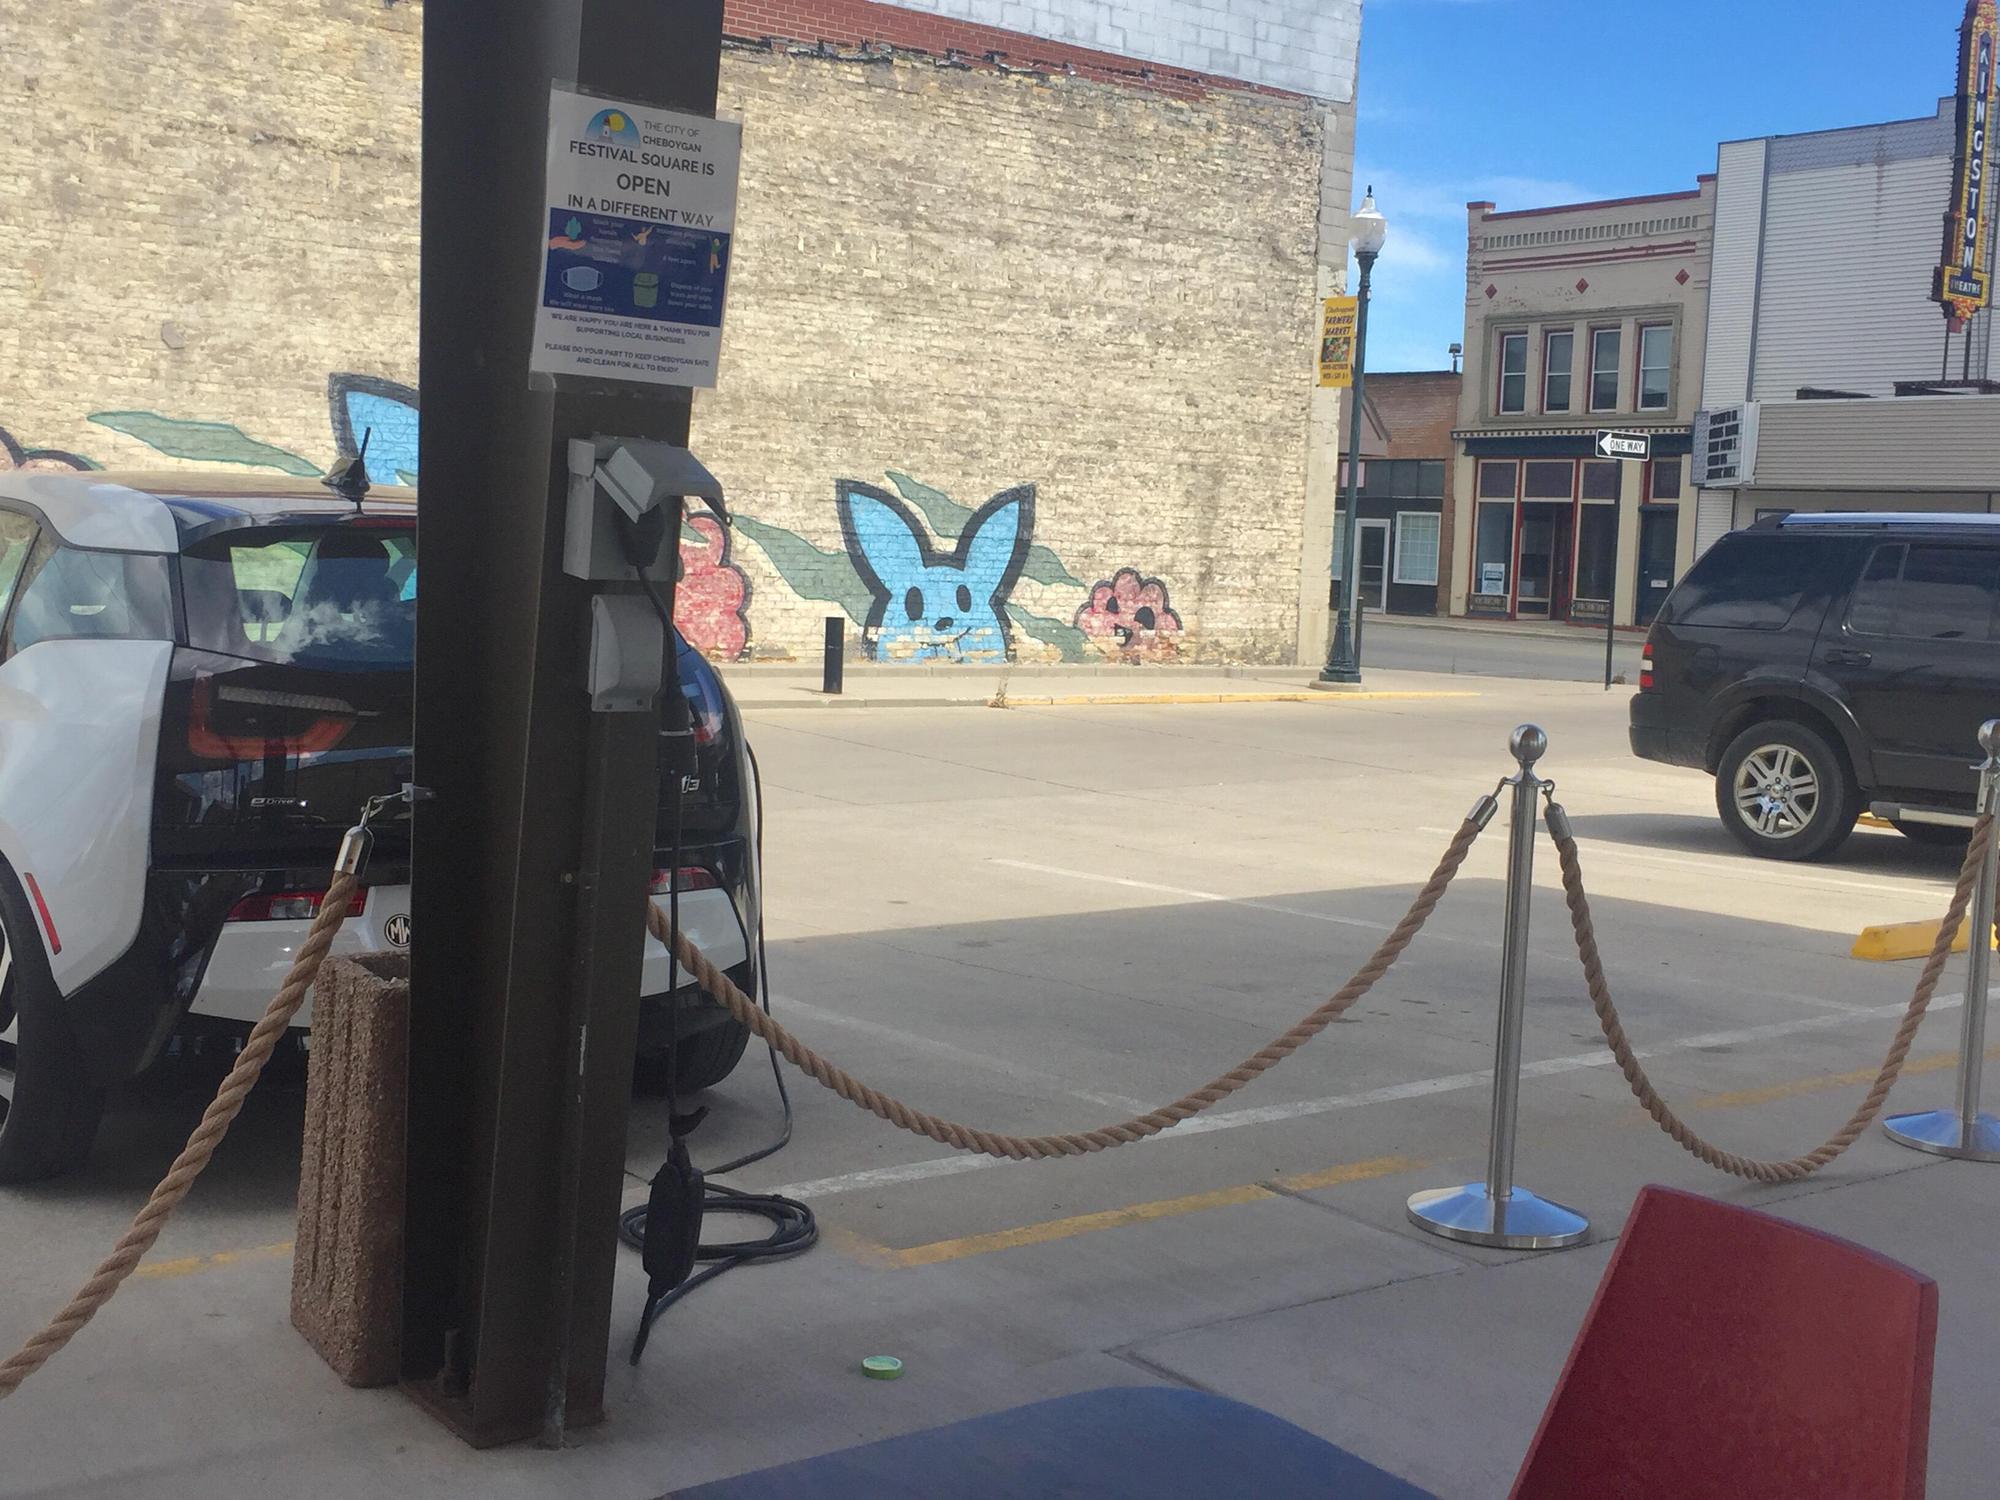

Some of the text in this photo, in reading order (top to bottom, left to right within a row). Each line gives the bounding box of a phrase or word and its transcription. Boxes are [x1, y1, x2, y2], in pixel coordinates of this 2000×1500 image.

[644, 120, 700, 137] THE CITY OF
[642, 136, 702, 153] CHEBOYGAN
[570, 140, 715, 176] FESTIVAL SQUARE IS
[1963, 47, 1989, 268] KINGSTON
[617, 173, 671, 197] OPEN
[568, 194, 714, 227] IN A DIFFERENT WAY
[565, 314, 577, 322] ARE
[579, 316, 601, 325] HAPPY
[619, 321, 633, 329] ARE
[576, 326, 620, 337] SUPPORTING
[621, 331, 642, 340] LOCAL
[545, 343, 570, 352] PLEASE
[585, 347, 603, 355] YOUR
[605, 350, 623, 358] PART
[653, 355, 693, 365] CHEBOYGAN
[593, 358, 615, 367] CLEAN
[617, 360, 631, 368] FOR
[632, 362, 645, 370] ALL
[1610, 440, 1644, 452] ONE WAY
